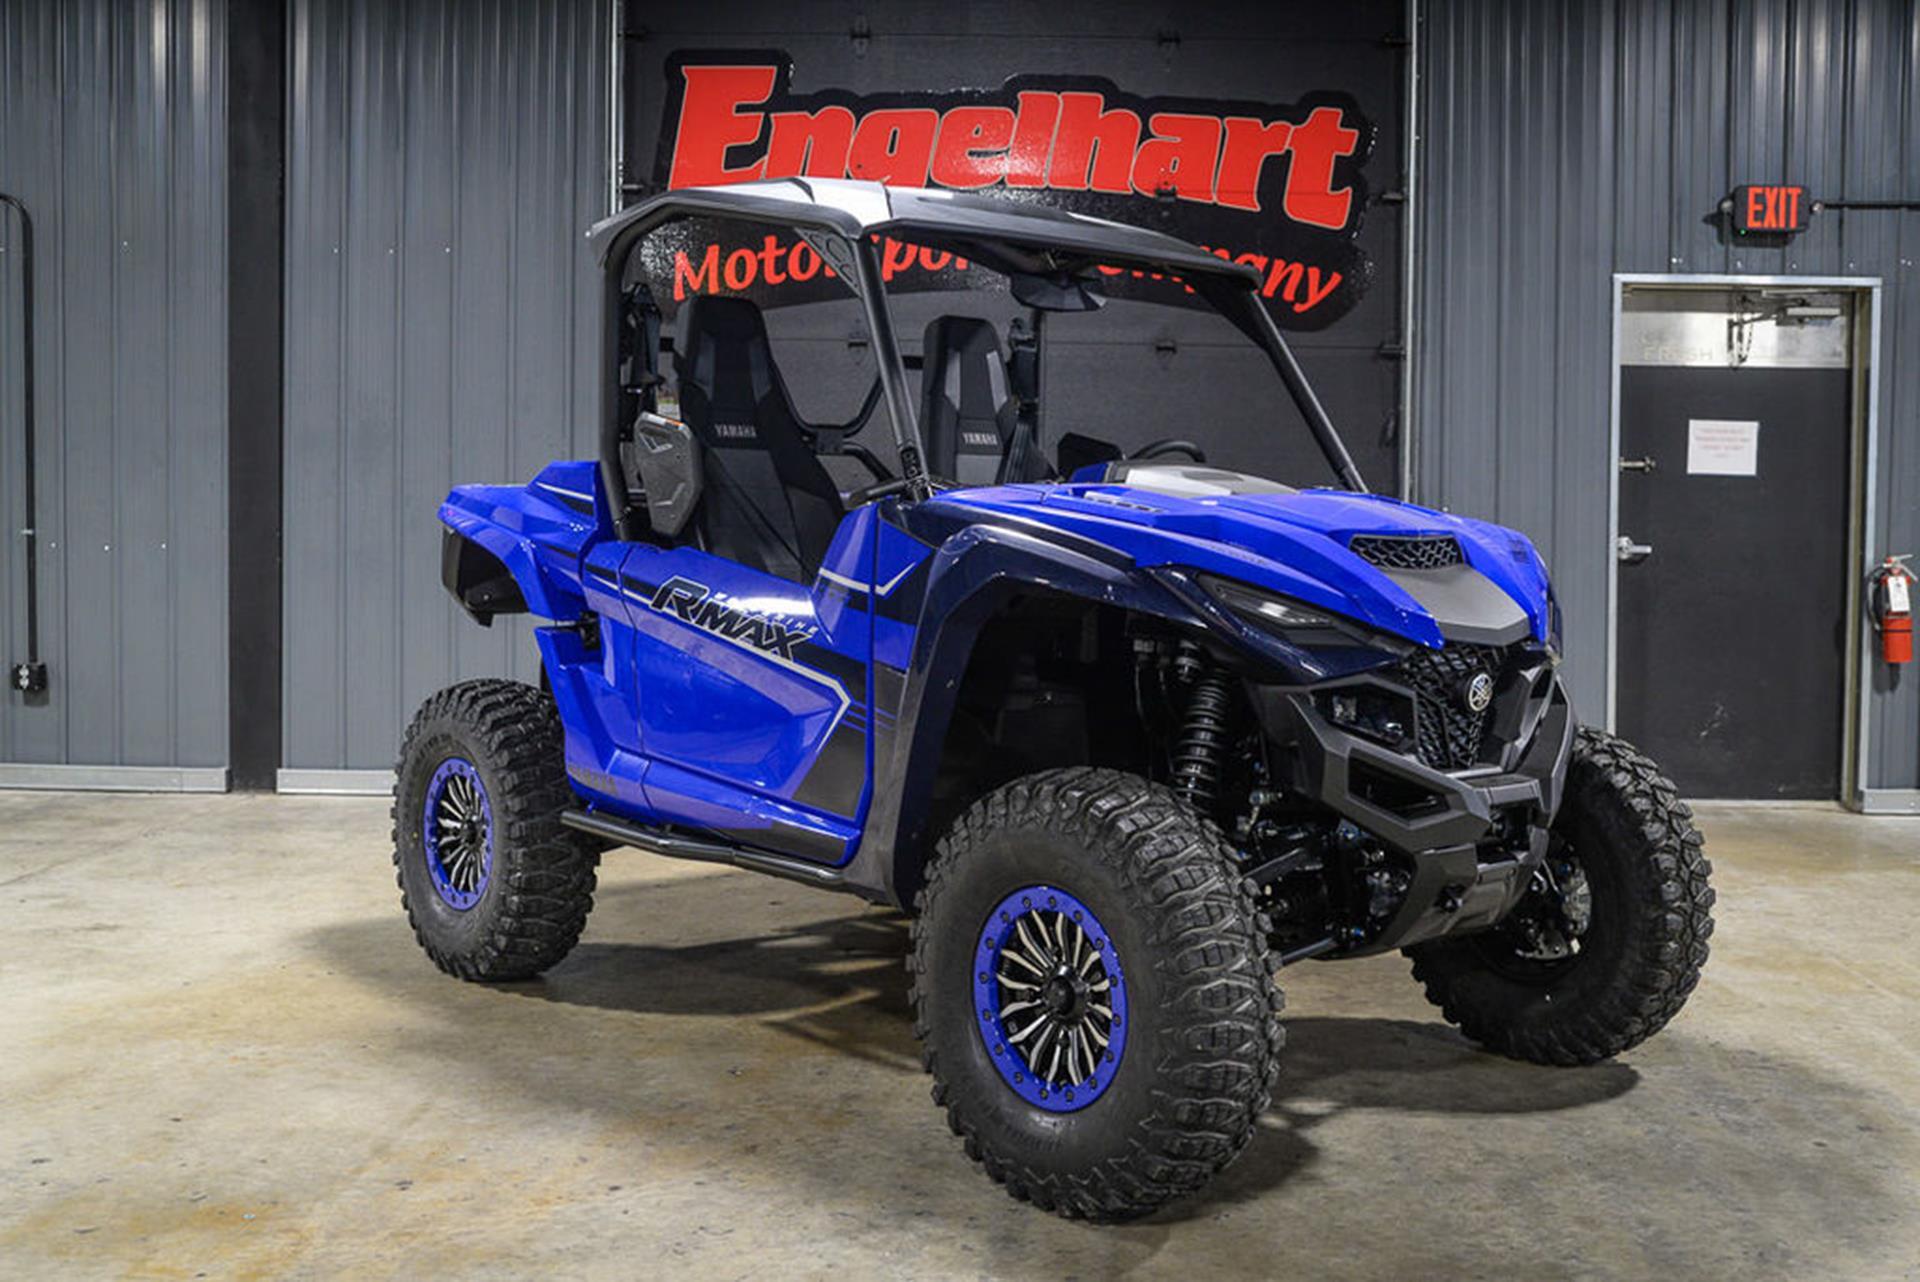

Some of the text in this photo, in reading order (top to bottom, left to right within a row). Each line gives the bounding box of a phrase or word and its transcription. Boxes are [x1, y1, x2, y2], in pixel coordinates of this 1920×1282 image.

[667, 65, 1359, 230] Engelhart
[1746, 186, 1802, 229] EXIT
[714, 424, 757, 438] YAMAHA
[961, 432, 998, 445] YAMAHA
[649, 574, 813, 662] RMAX
